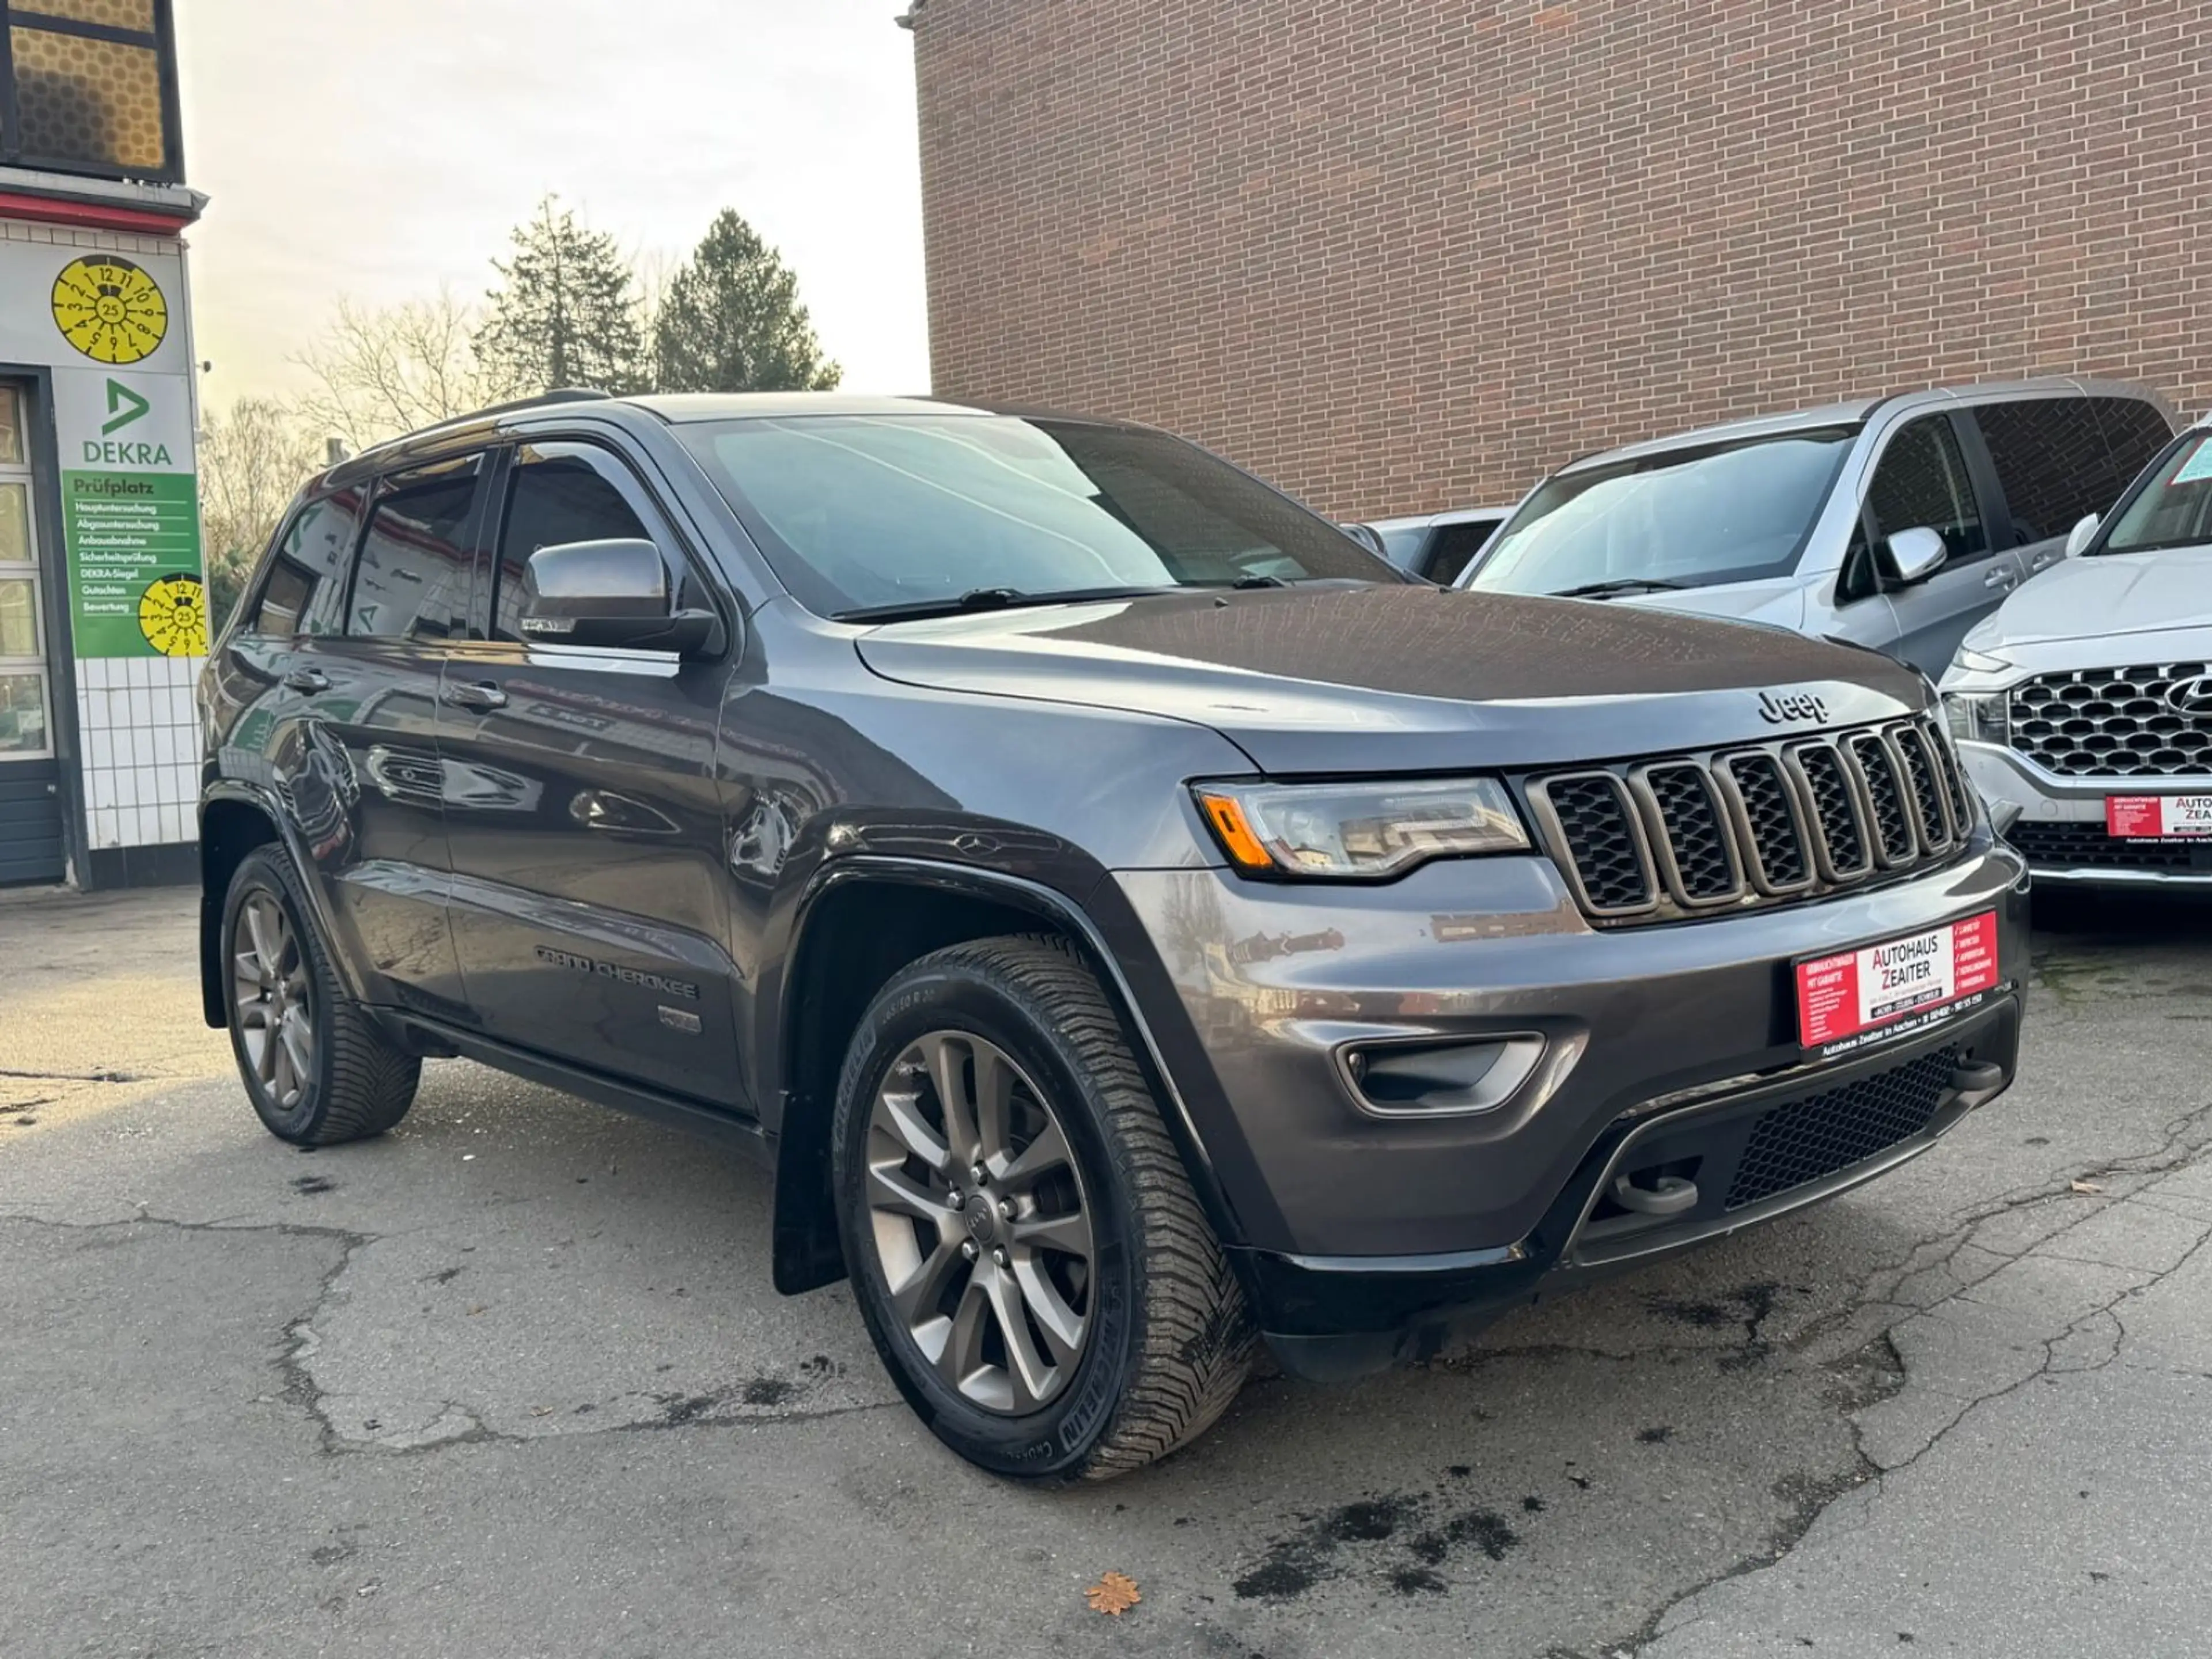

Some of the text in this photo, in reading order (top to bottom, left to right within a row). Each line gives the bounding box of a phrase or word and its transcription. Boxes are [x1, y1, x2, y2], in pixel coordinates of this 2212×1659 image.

[84, 273, 94, 286] 1
[100, 268, 113, 281] 12
[120, 272, 133, 288] 11
[70, 285, 85, 297] 2
[133, 287, 150, 302] 10
[67, 303, 83, 311] 3
[103, 304, 118, 316] 25
[137, 323, 150, 334] 8
[90, 332, 101, 344] 5
[110, 337, 117, 350] 6
[128, 332, 137, 347] 7
[83, 441, 172, 465] DEKRA
[74, 478, 154, 497] Prüfplatz
[76, 502, 157, 515] Hauptuntersuchung
[77, 518, 160, 531] Abgasuntersuchung
[78, 535, 147, 545] Anbauabnahme
[79, 551, 157, 563] Sicherheitsprüfung
[80, 568, 139, 580] DEKRA-Siegel
[81, 585, 126, 594] Gutachten
[164, 589, 172, 599] 1
[176, 582, 187, 594] 12
[192, 585, 202, 598] 11
[84, 602, 130, 613] Bewertung
[153, 599, 165, 608] 2
[177, 612, 191, 622] 25
[1758, 691, 1830, 724] Jeep
[1873, 935, 1938, 970] AUTOHAUS
[533, 945, 700, 1000] GRAND CHEROKEE
[1881, 960, 1931, 990] ZEAITER
[1822, 1039, 1857, 1056] Autohaus
